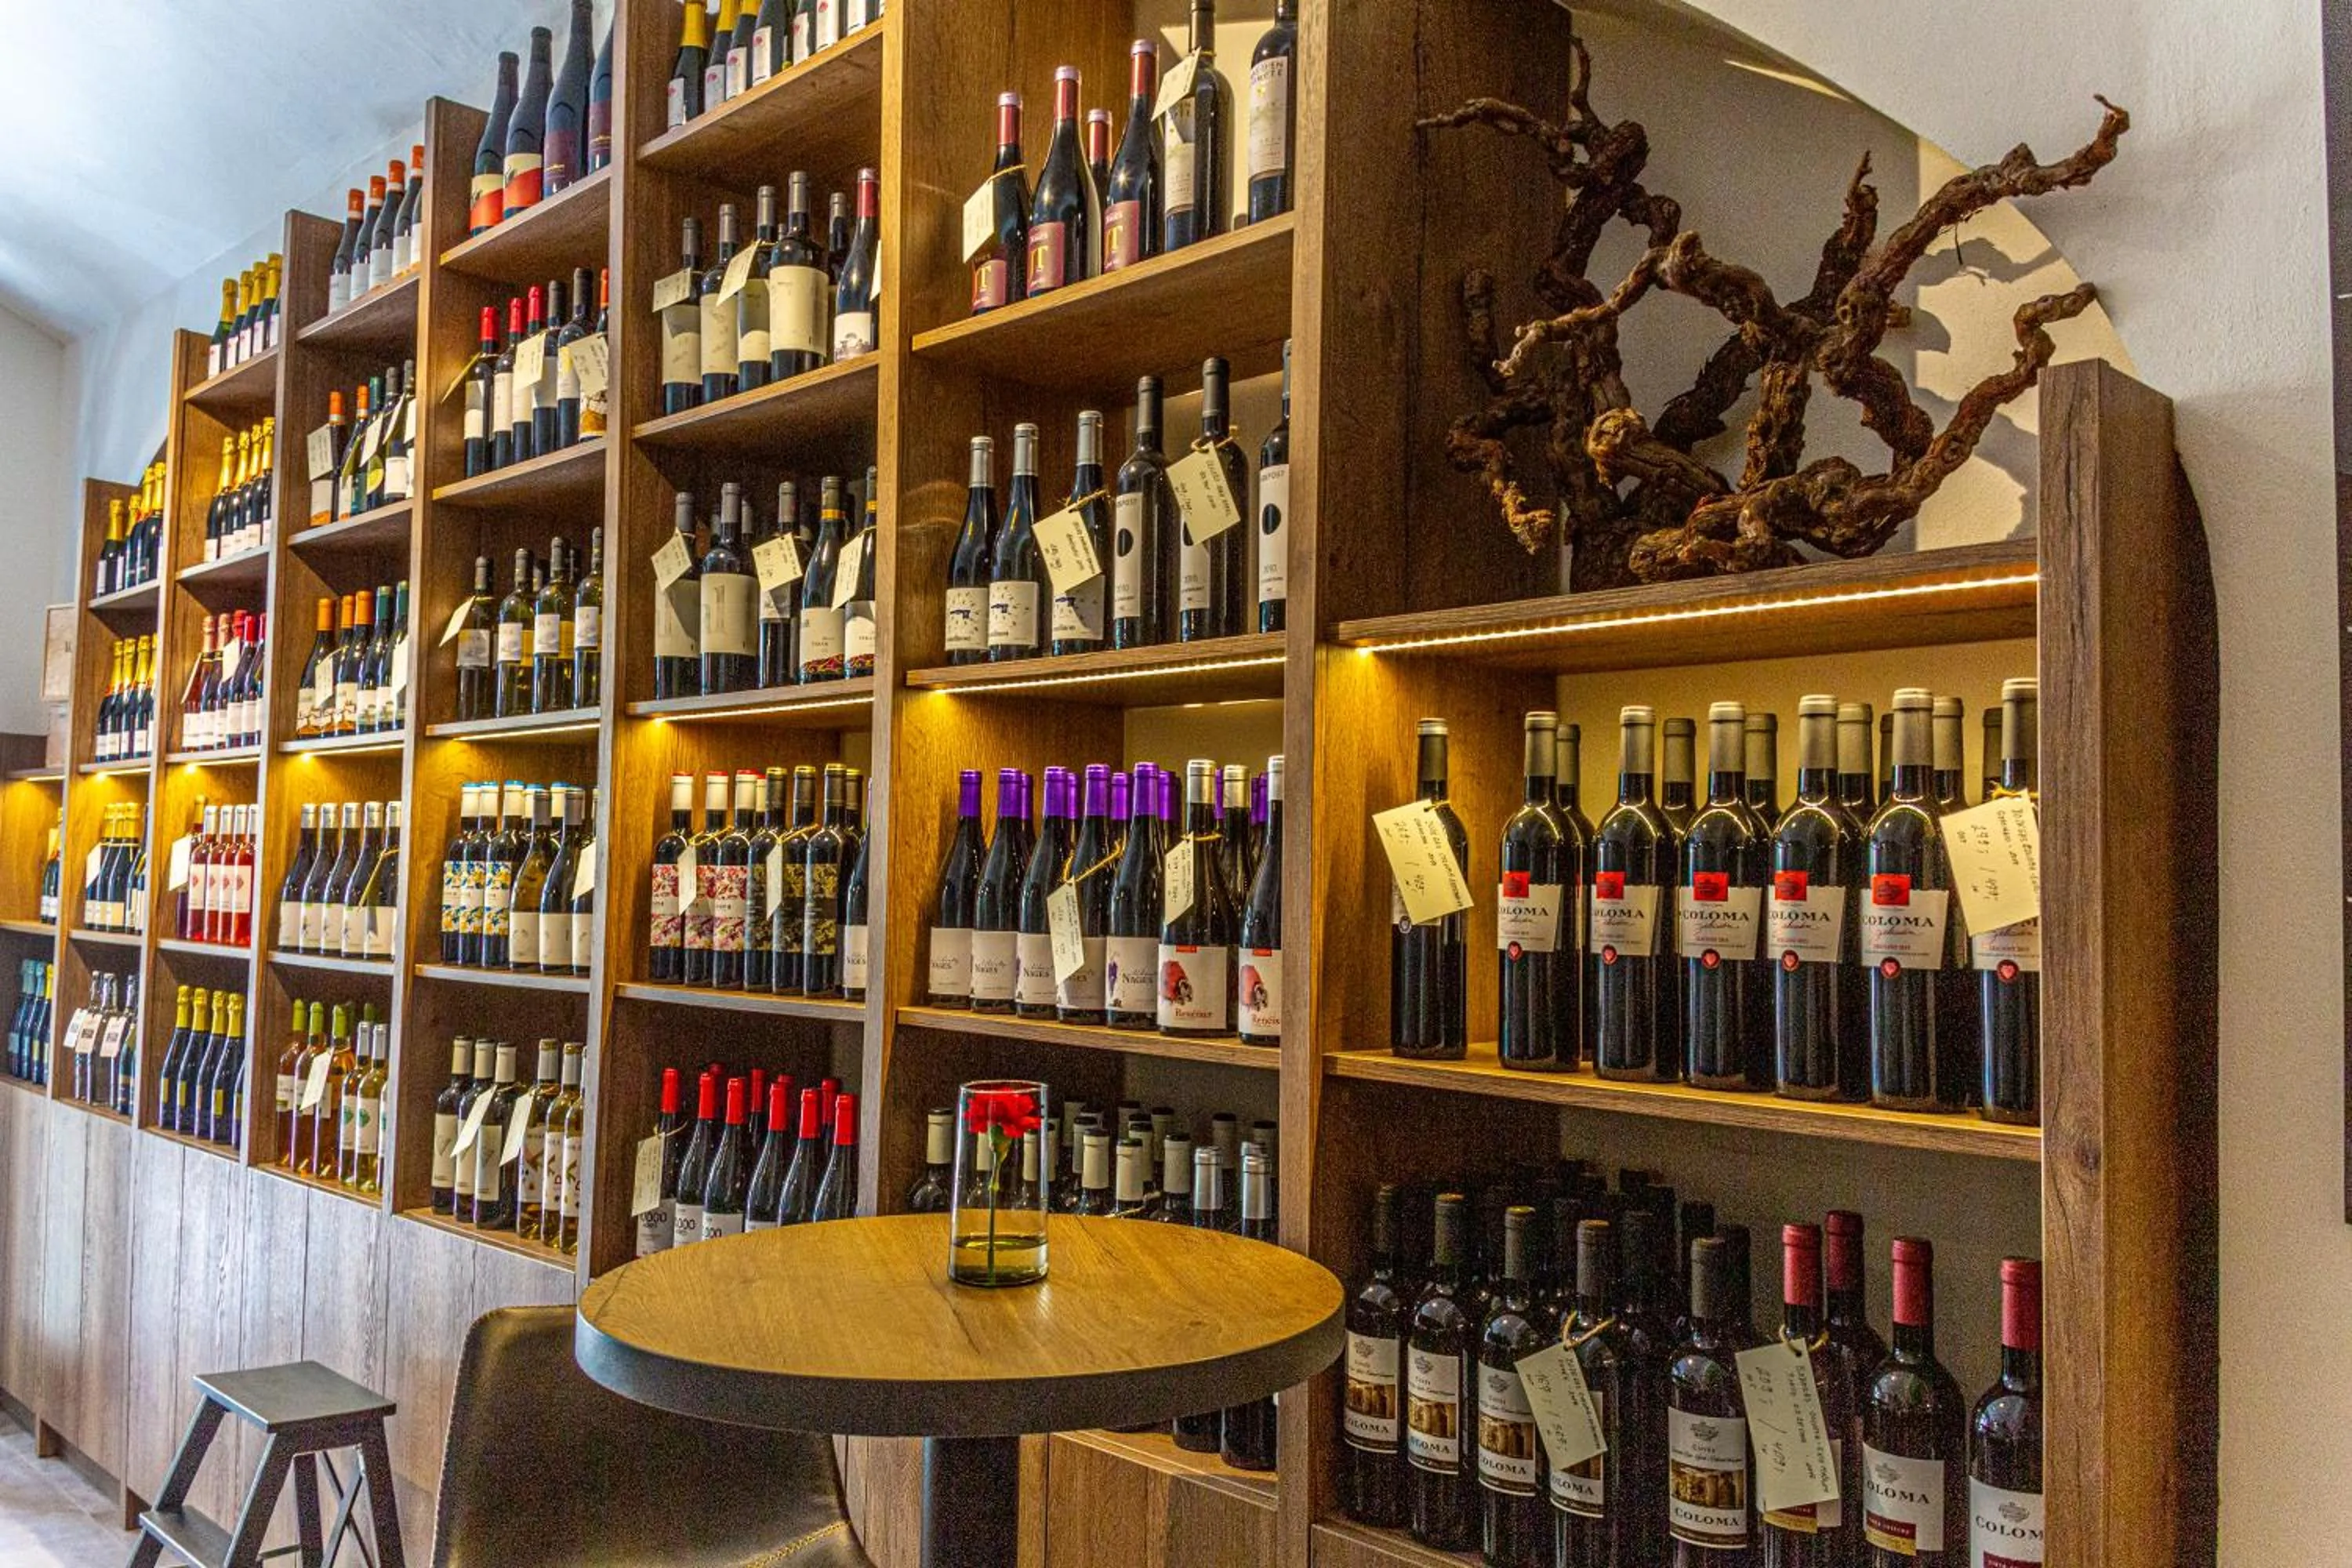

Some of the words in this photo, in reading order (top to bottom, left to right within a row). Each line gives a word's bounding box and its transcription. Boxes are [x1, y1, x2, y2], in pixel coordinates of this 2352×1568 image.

[1348, 1417, 1390, 1434] OLOMA
[1411, 1436, 1450, 1454] OLOMA
[1552, 1475, 1594, 1496] OLOMA
[1866, 1480, 1930, 1504] OLOMA
[1674, 1507, 1740, 1527] COLOMA
